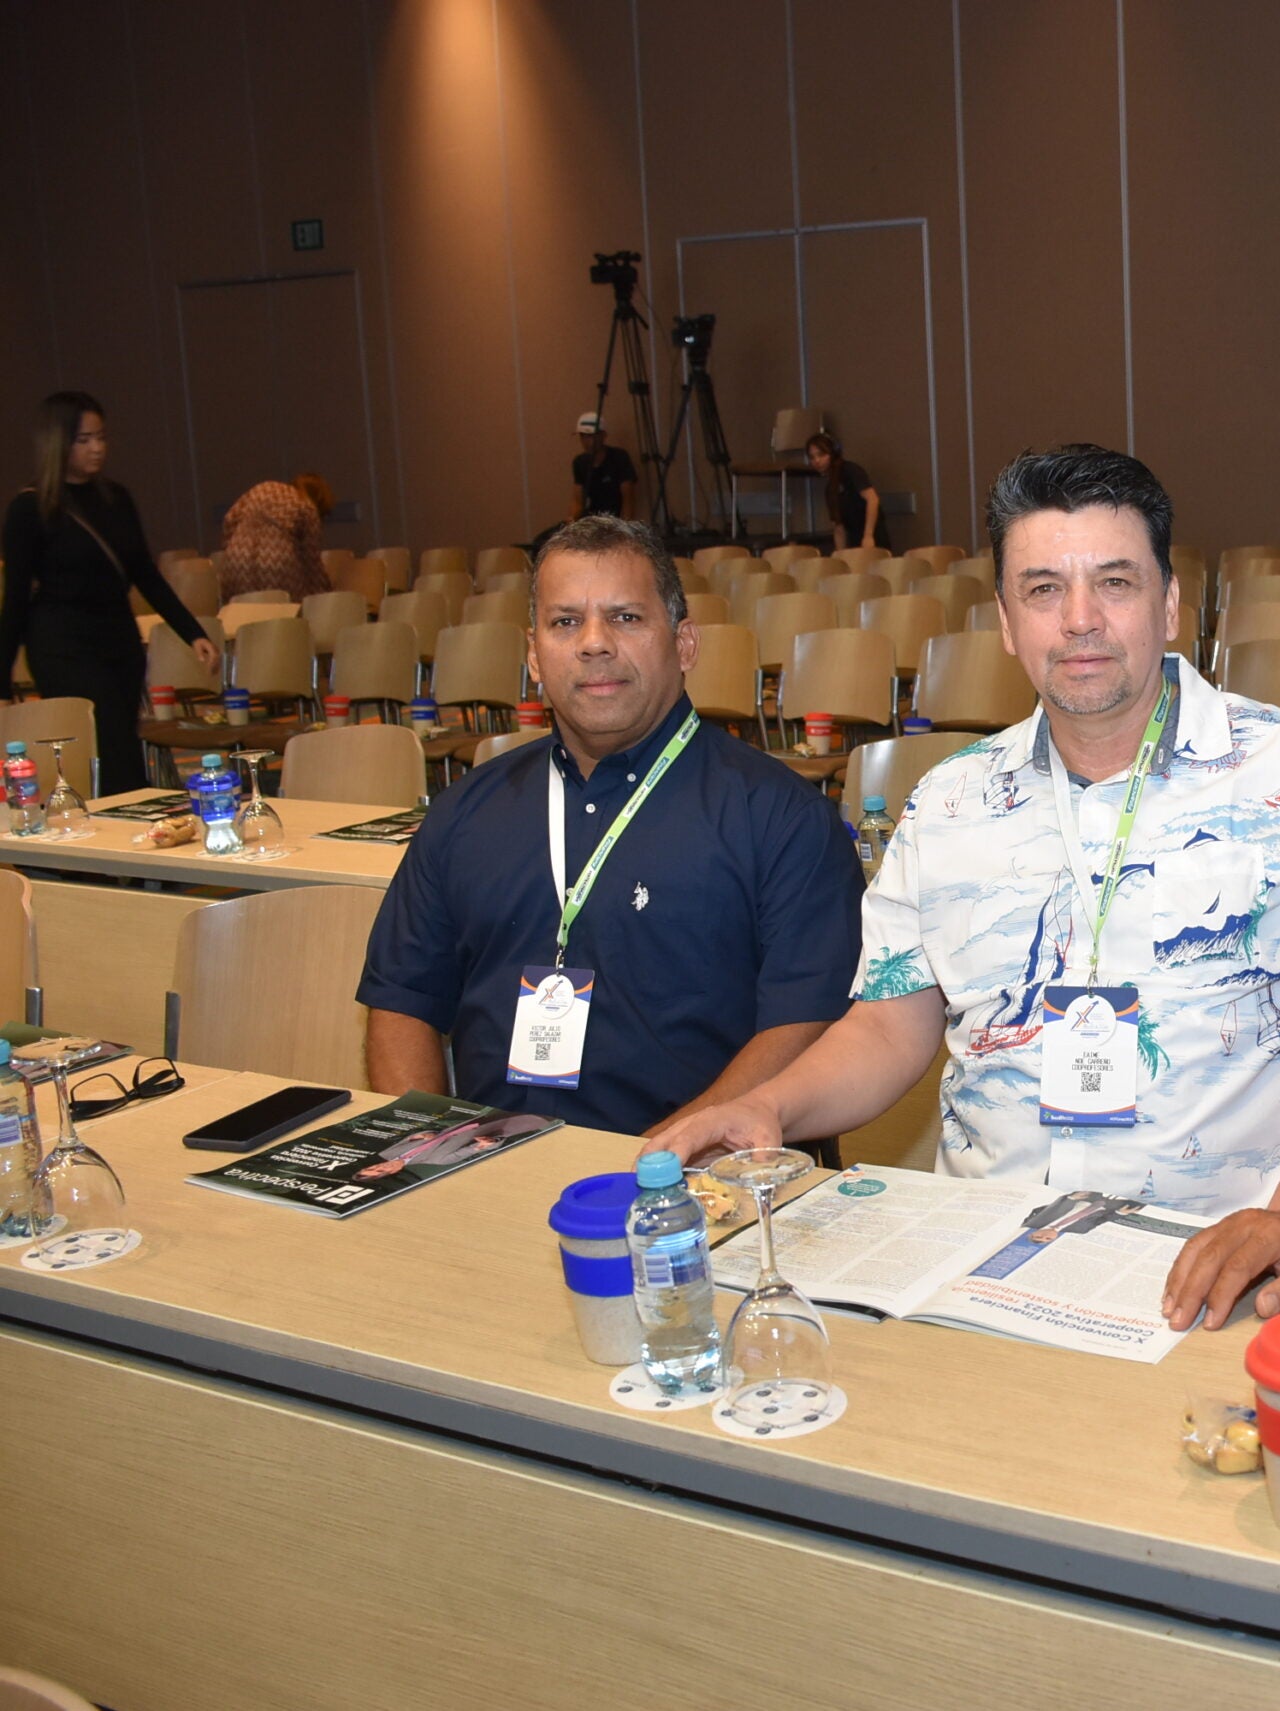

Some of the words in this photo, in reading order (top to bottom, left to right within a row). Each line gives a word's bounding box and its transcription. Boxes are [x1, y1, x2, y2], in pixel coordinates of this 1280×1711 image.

[224, 1168, 333, 1196] Perspectiva
[951, 1287, 1020, 1305] resiliencia
[963, 1280, 1060, 1307] sostenibilidad
[969, 1296, 1043, 1322] Financiera
[1074, 1307, 1162, 1329] cooperación
[1045, 1317, 1132, 1342] Convención
[1065, 1313, 1155, 1337] Cooperativa
[1134, 1337, 1148, 1345] X
